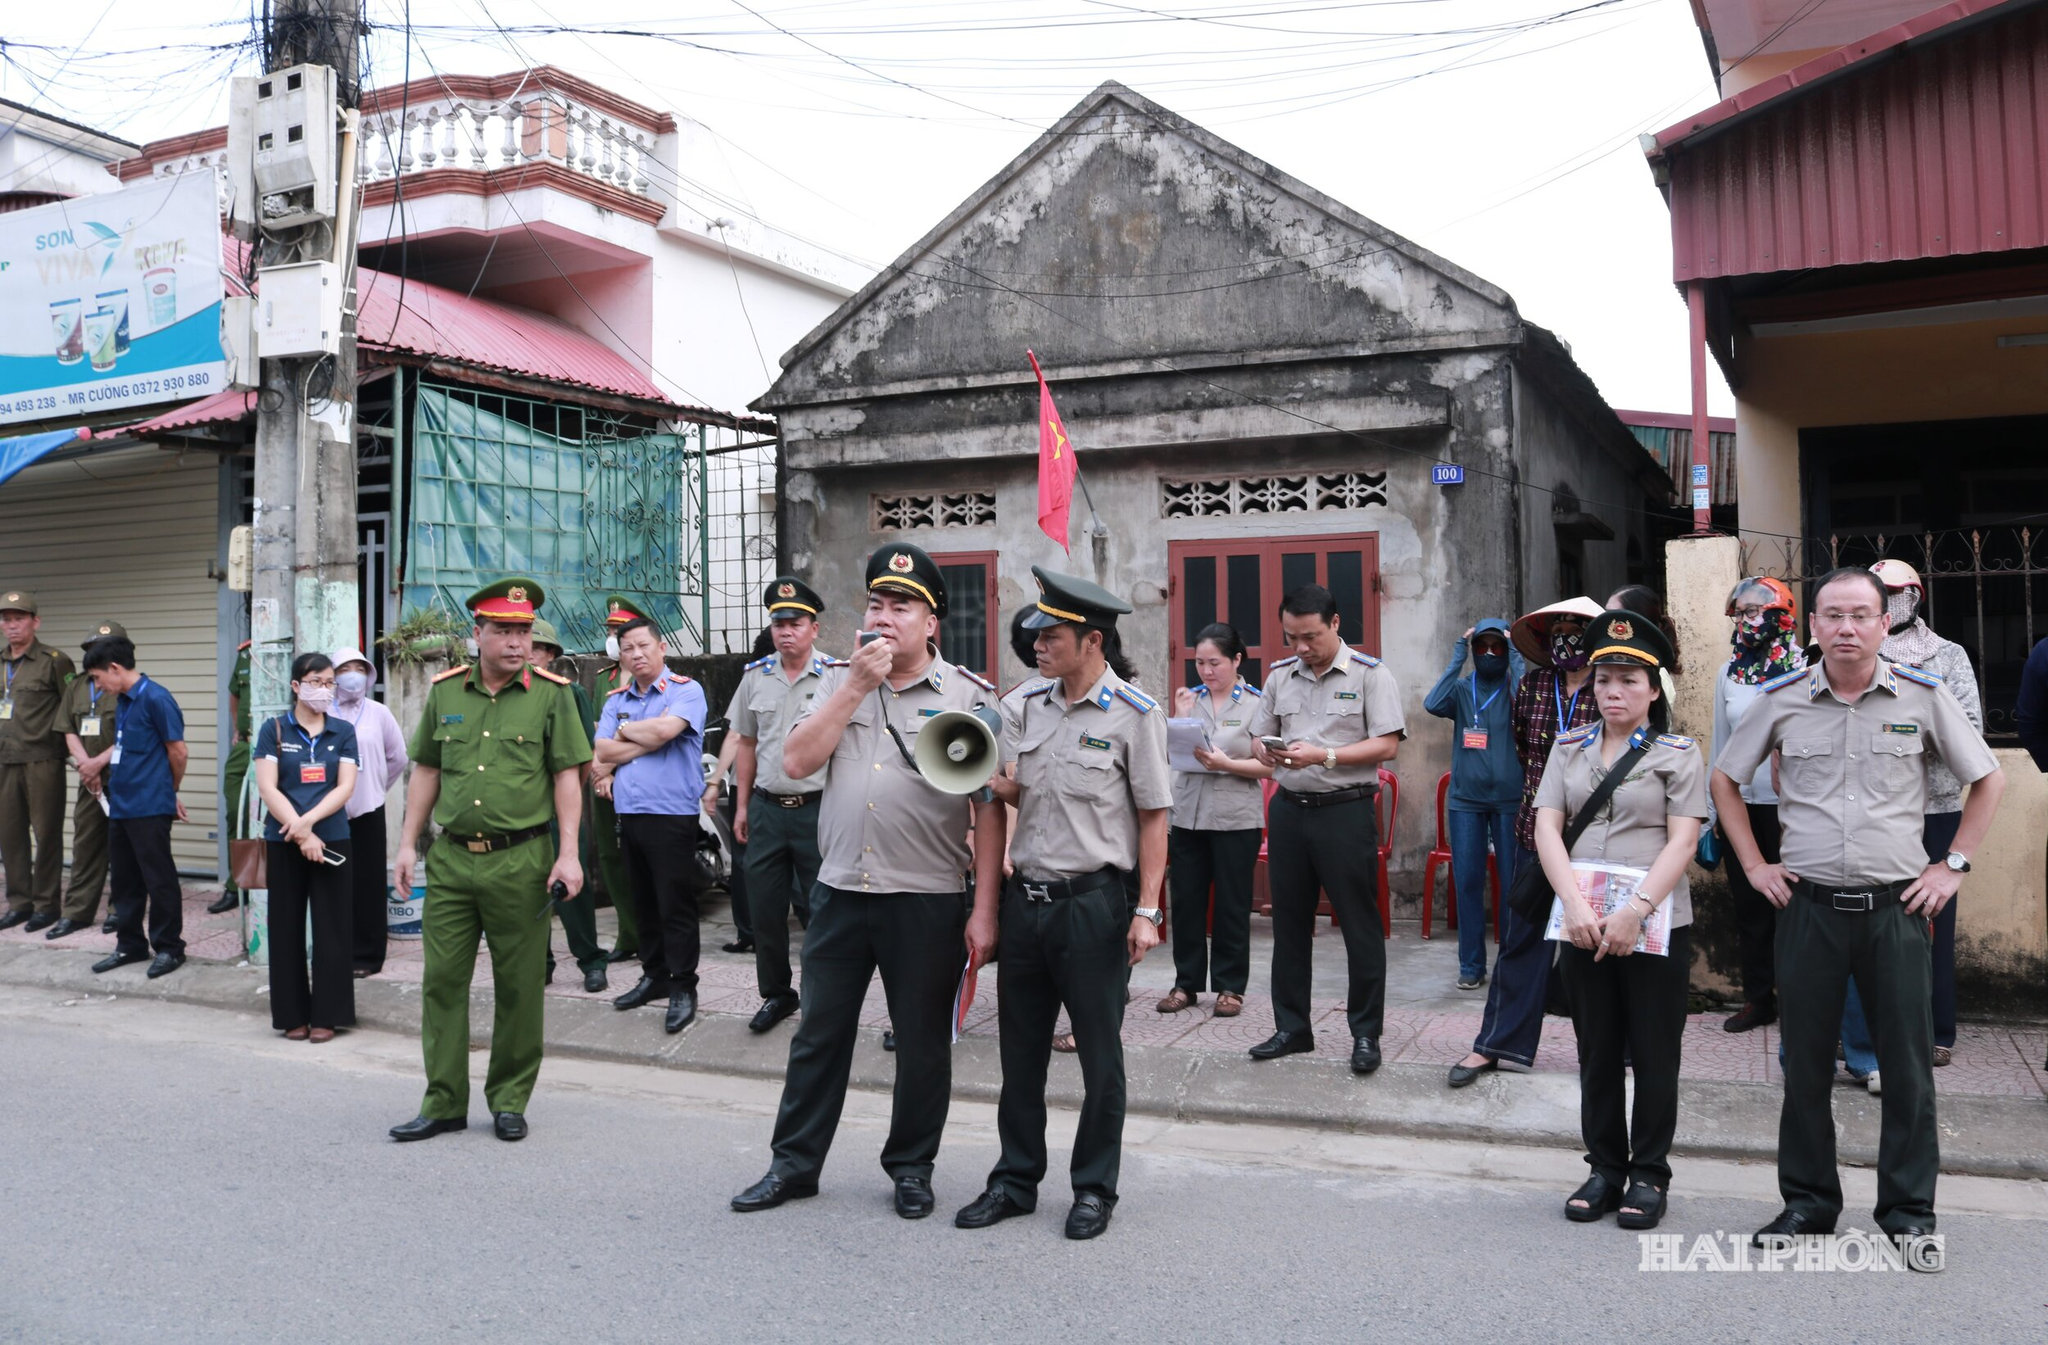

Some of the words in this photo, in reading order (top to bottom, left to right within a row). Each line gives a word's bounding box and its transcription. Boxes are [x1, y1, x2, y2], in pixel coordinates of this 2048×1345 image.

[15, 400, 34, 412] 493
[37, 396, 56, 410] 238
[68, 392, 86, 405] MR
[132, 381, 160, 396] 0372
[163, 376, 184, 391] 930
[188, 372, 209, 387] 880
[1437, 468, 1457, 480] 100
